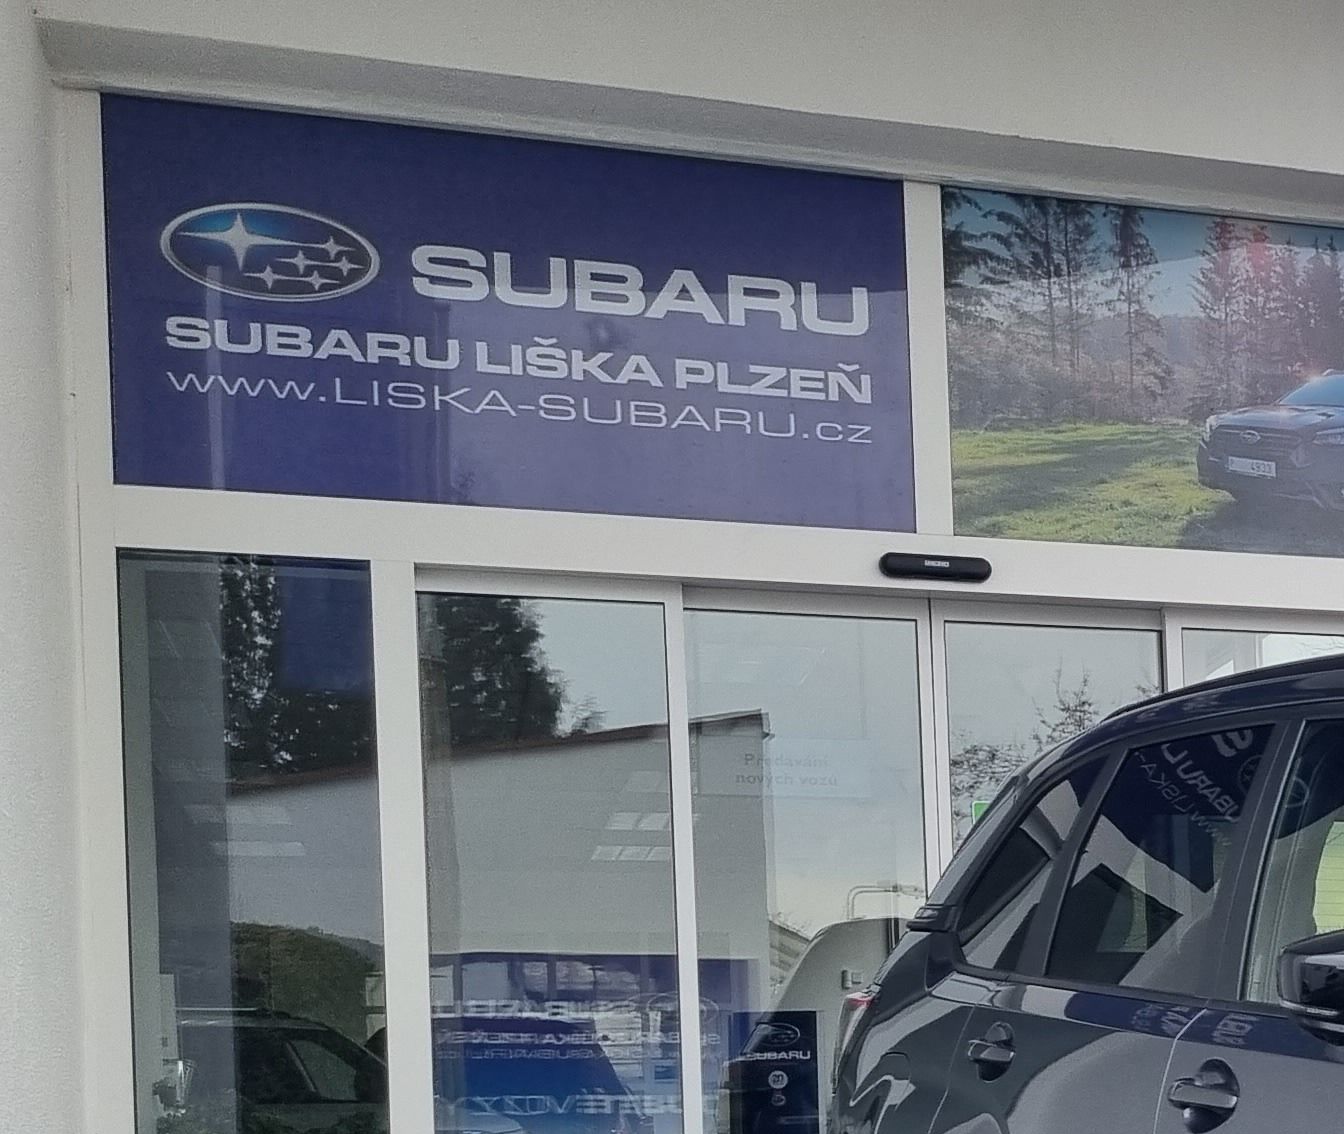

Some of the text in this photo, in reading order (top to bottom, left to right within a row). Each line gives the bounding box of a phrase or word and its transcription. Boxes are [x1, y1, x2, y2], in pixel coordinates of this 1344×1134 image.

[411, 243, 871, 337] SUBARU
[165, 316, 872, 404] SUBARU LIŠKA PLZEŇ
[166, 371, 873, 445] www.LISKA-SUBARU.cz
